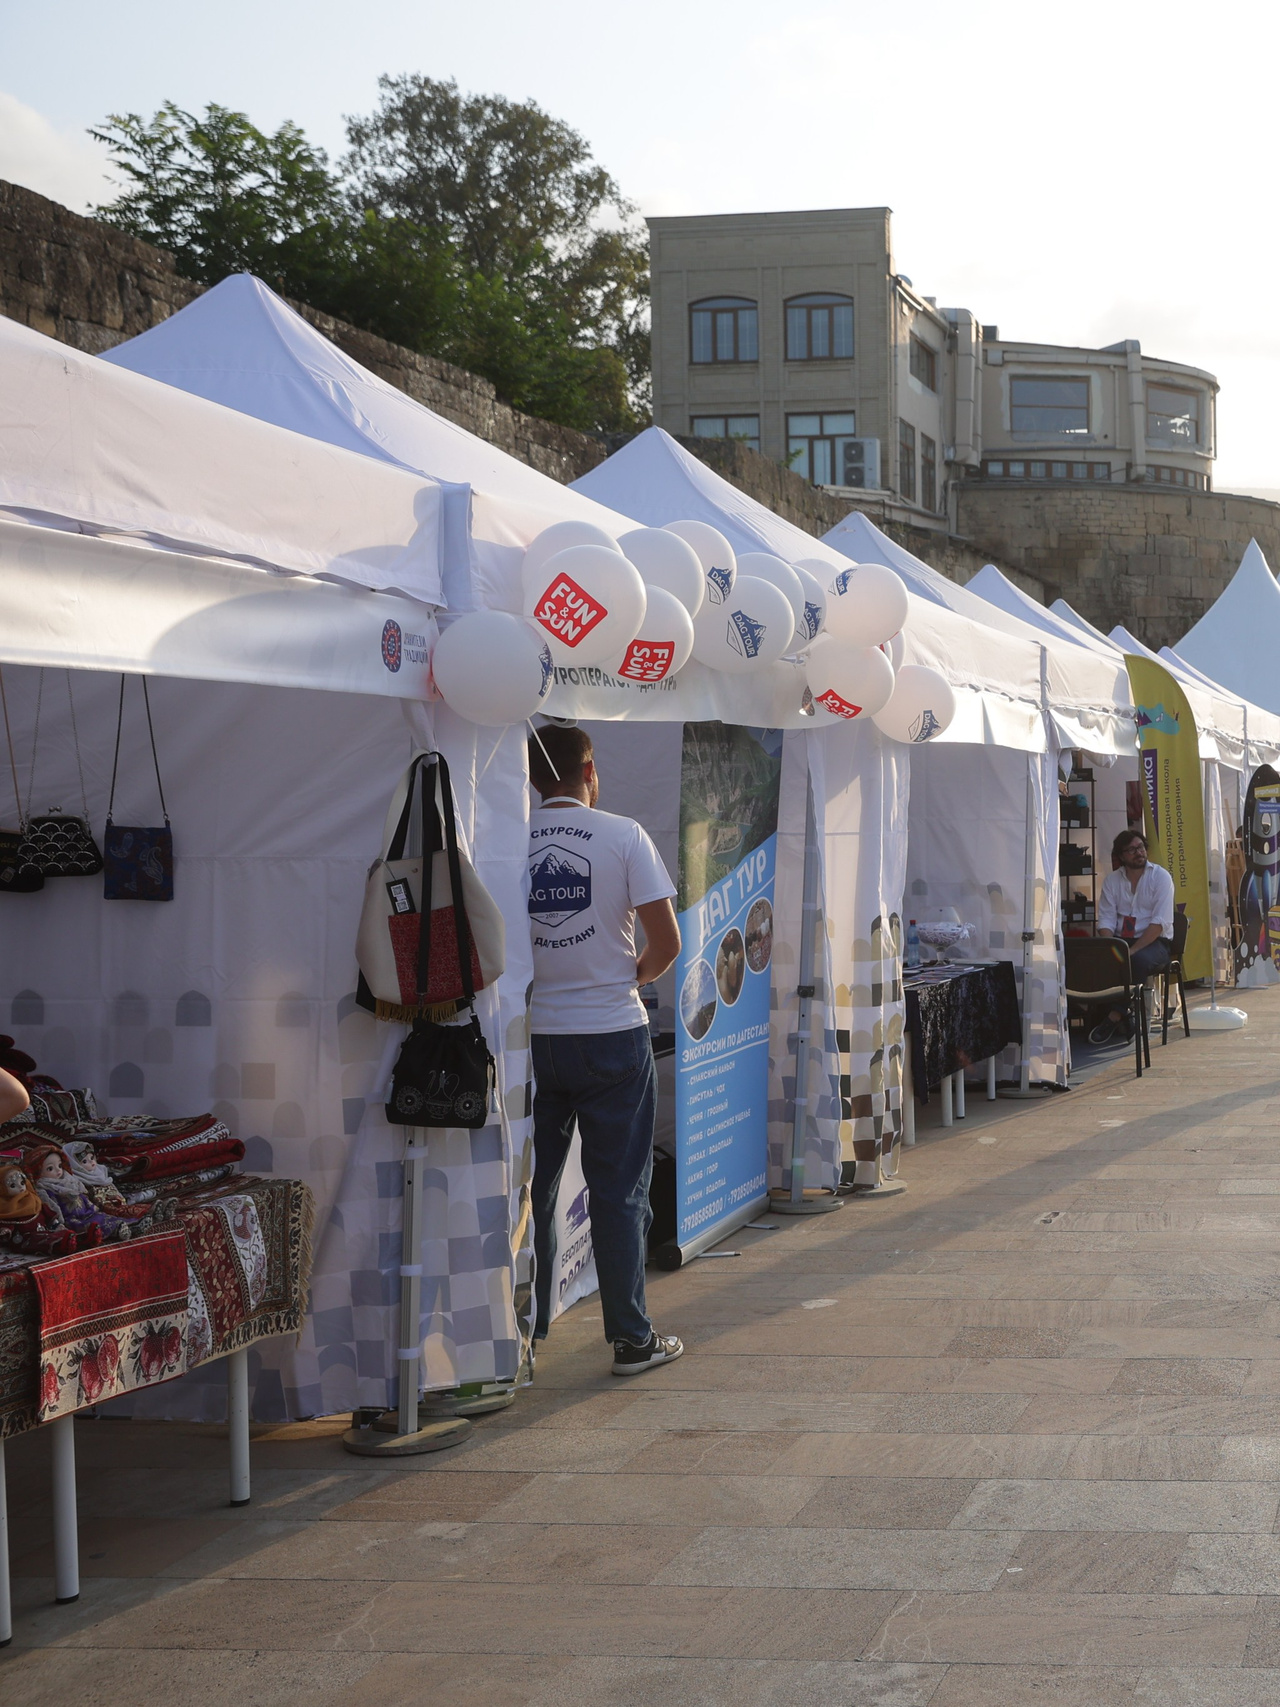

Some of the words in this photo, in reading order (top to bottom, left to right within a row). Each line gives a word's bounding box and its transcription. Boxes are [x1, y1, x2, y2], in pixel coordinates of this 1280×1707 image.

[551, 582, 597, 625] FUN
[559, 607, 569, 618] &
[539, 601, 581, 641] SUN
[734, 614, 748, 634] DAG
[743, 634, 756, 656] TOUR
[625, 645, 650, 678] SUN
[643, 648, 669, 680] FUN
[531, 826, 593, 841] СКУРСИИ
[1175, 778, 1187, 888] программирования
[529, 889, 546, 902] AG
[549, 886, 586, 900] TOUR
[698, 879, 733, 948] ДАГ
[736, 849, 767, 900] ТУР
[534, 925, 596, 949] ДАГЕСТАНУ
[681, 1038, 726, 1063] ЭКСКУРСИИ
[727, 1033, 737, 1048] ПО
